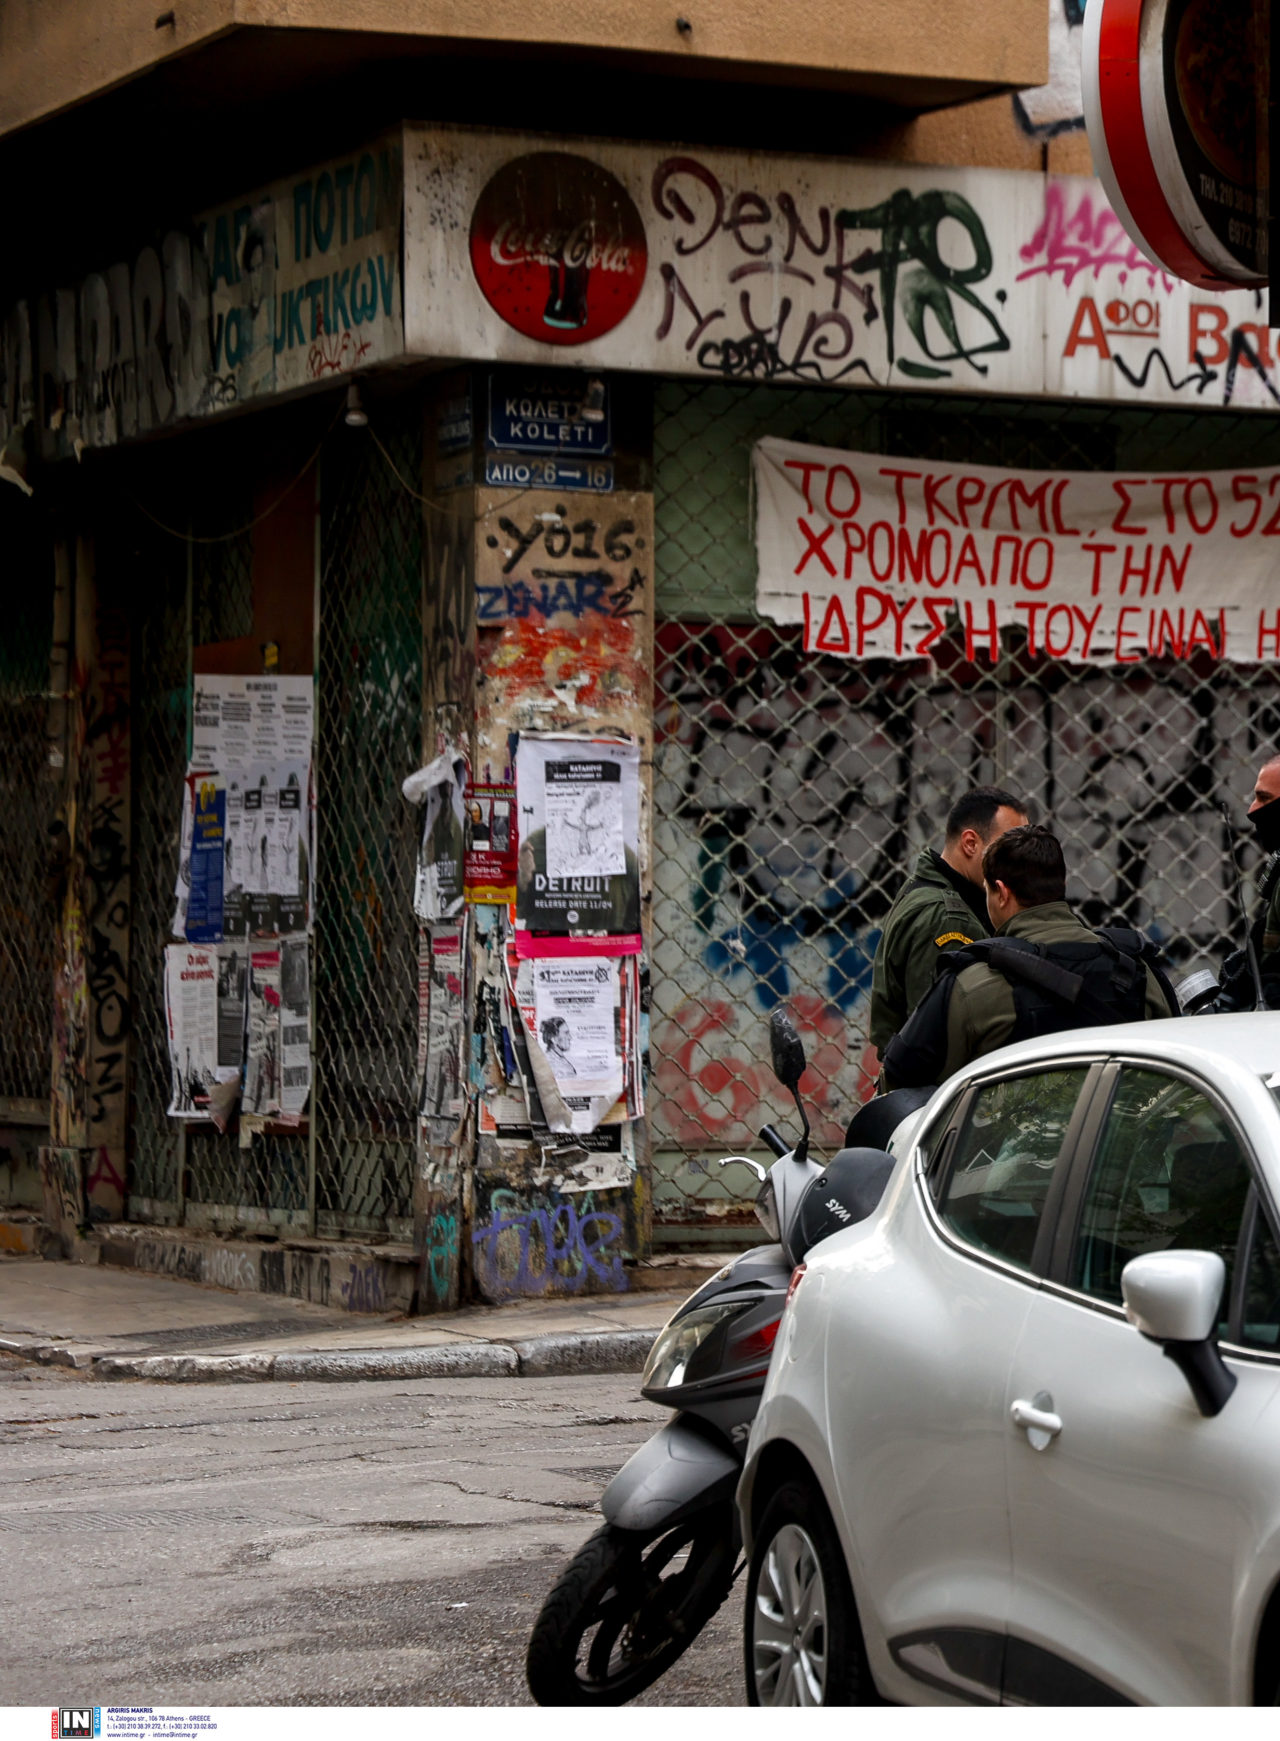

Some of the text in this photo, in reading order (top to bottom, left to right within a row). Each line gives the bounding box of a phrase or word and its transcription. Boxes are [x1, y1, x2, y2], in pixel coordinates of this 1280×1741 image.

[510, 421, 593, 442] KOLETI
[491, 461, 606, 487] ΑΠΟ 26 16
[1112, 477, 1219, 535] ΣΤΟ
[1081, 543, 1192, 597] ΤΗΝ
[802, 586, 998, 663] ΙΔΡΥΣΗ
[1014, 601, 1102, 659] ΤΟΥ
[1114, 606, 1226, 663] ΕΙΝΑΙ
[534, 899, 567, 909] RELEASE
[568, 899, 589, 909] DATE
[825, 1198, 852, 1222] SYM
